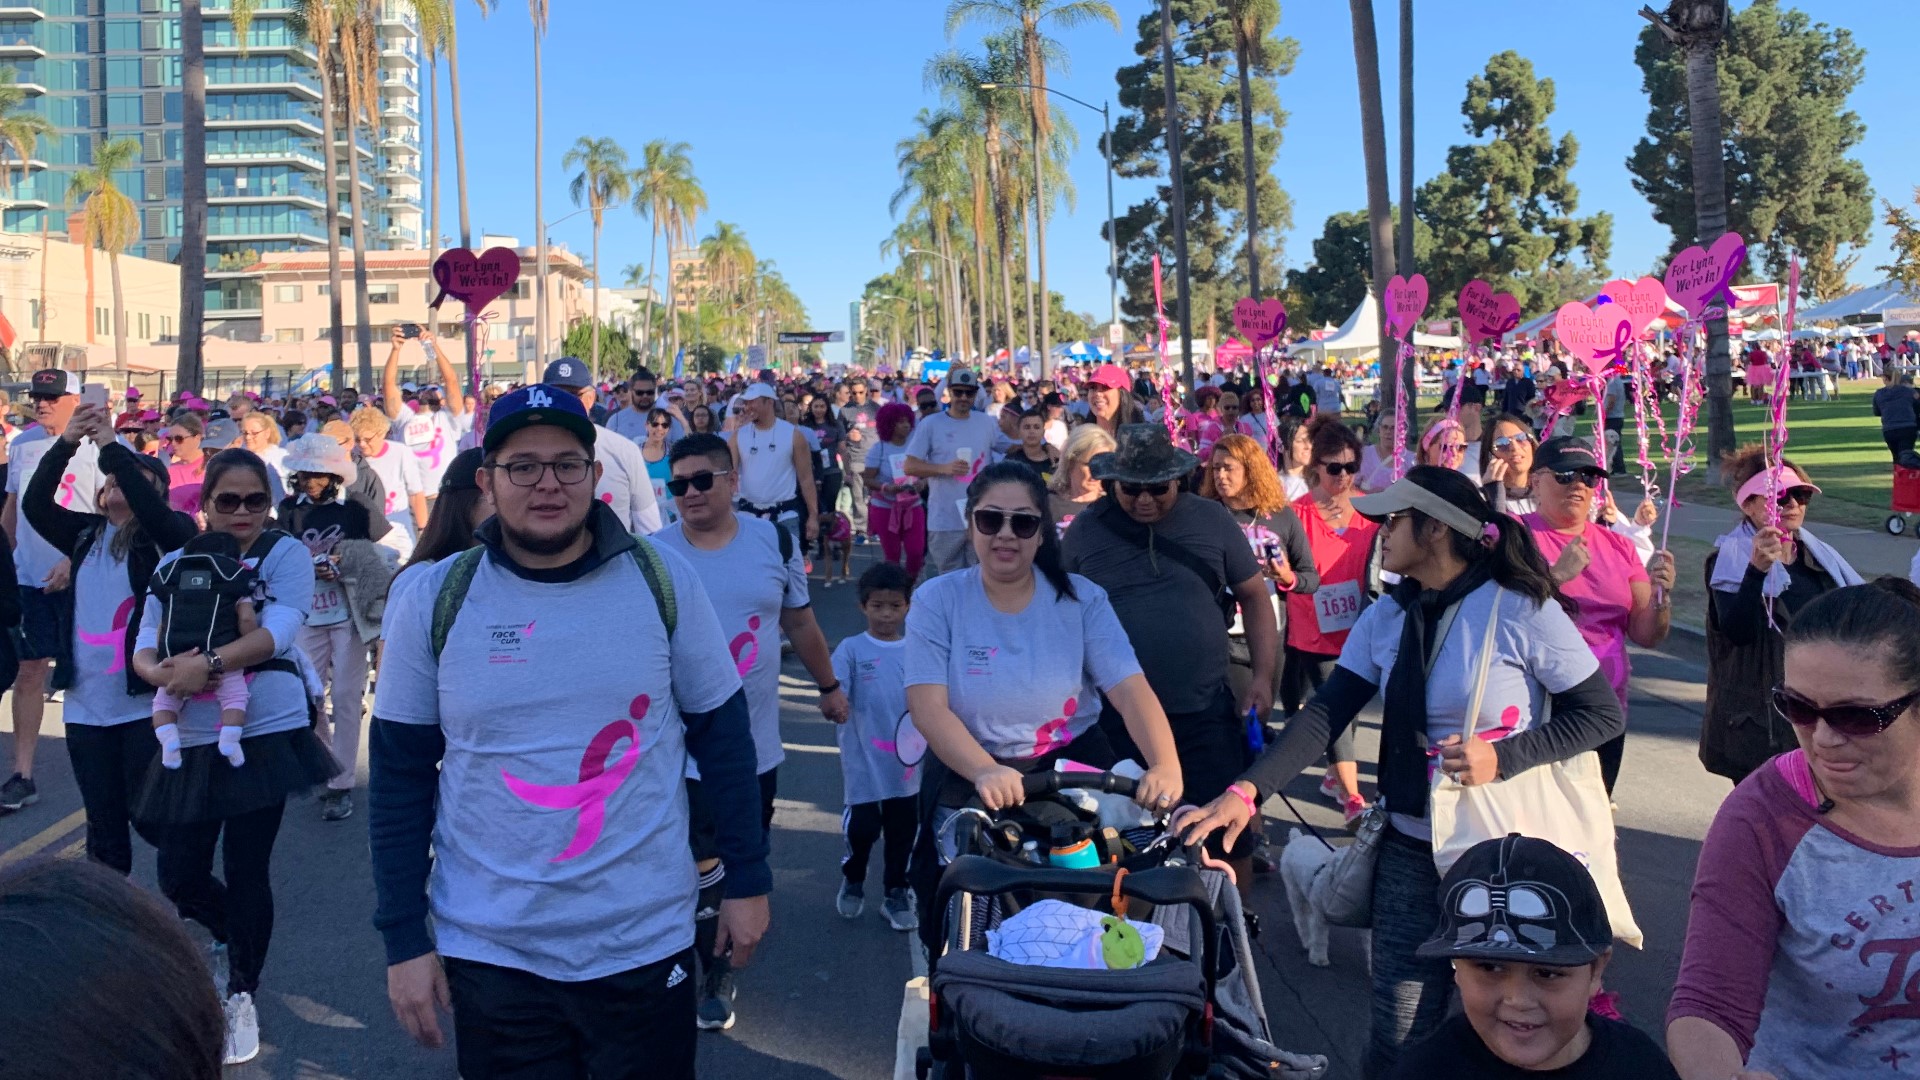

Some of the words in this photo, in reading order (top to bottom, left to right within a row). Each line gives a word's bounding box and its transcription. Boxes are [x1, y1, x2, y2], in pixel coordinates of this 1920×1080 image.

[453, 261, 470, 273] For
[1671, 265, 1688, 277] For
[460, 274, 489, 287] We're
[492, 272, 509, 287] In!
[1676, 274, 1703, 293] We're
[1705, 266, 1720, 283] In!
[1466, 287, 1479, 299] For
[1614, 293, 1628, 303] For
[1237, 306, 1247, 316] For
[1645, 301, 1658, 314] In!
[1241, 319, 1260, 329] We're
[1261, 319, 1272, 330] In!
[1562, 314, 1578, 326] For
[1569, 330, 1597, 343] We're
[1599, 331, 1613, 345] In!
[526, 386, 553, 408] LA
[1321, 595, 1357, 617] 1638
[491, 630, 516, 639] race
[500, 637, 521, 645] cure
